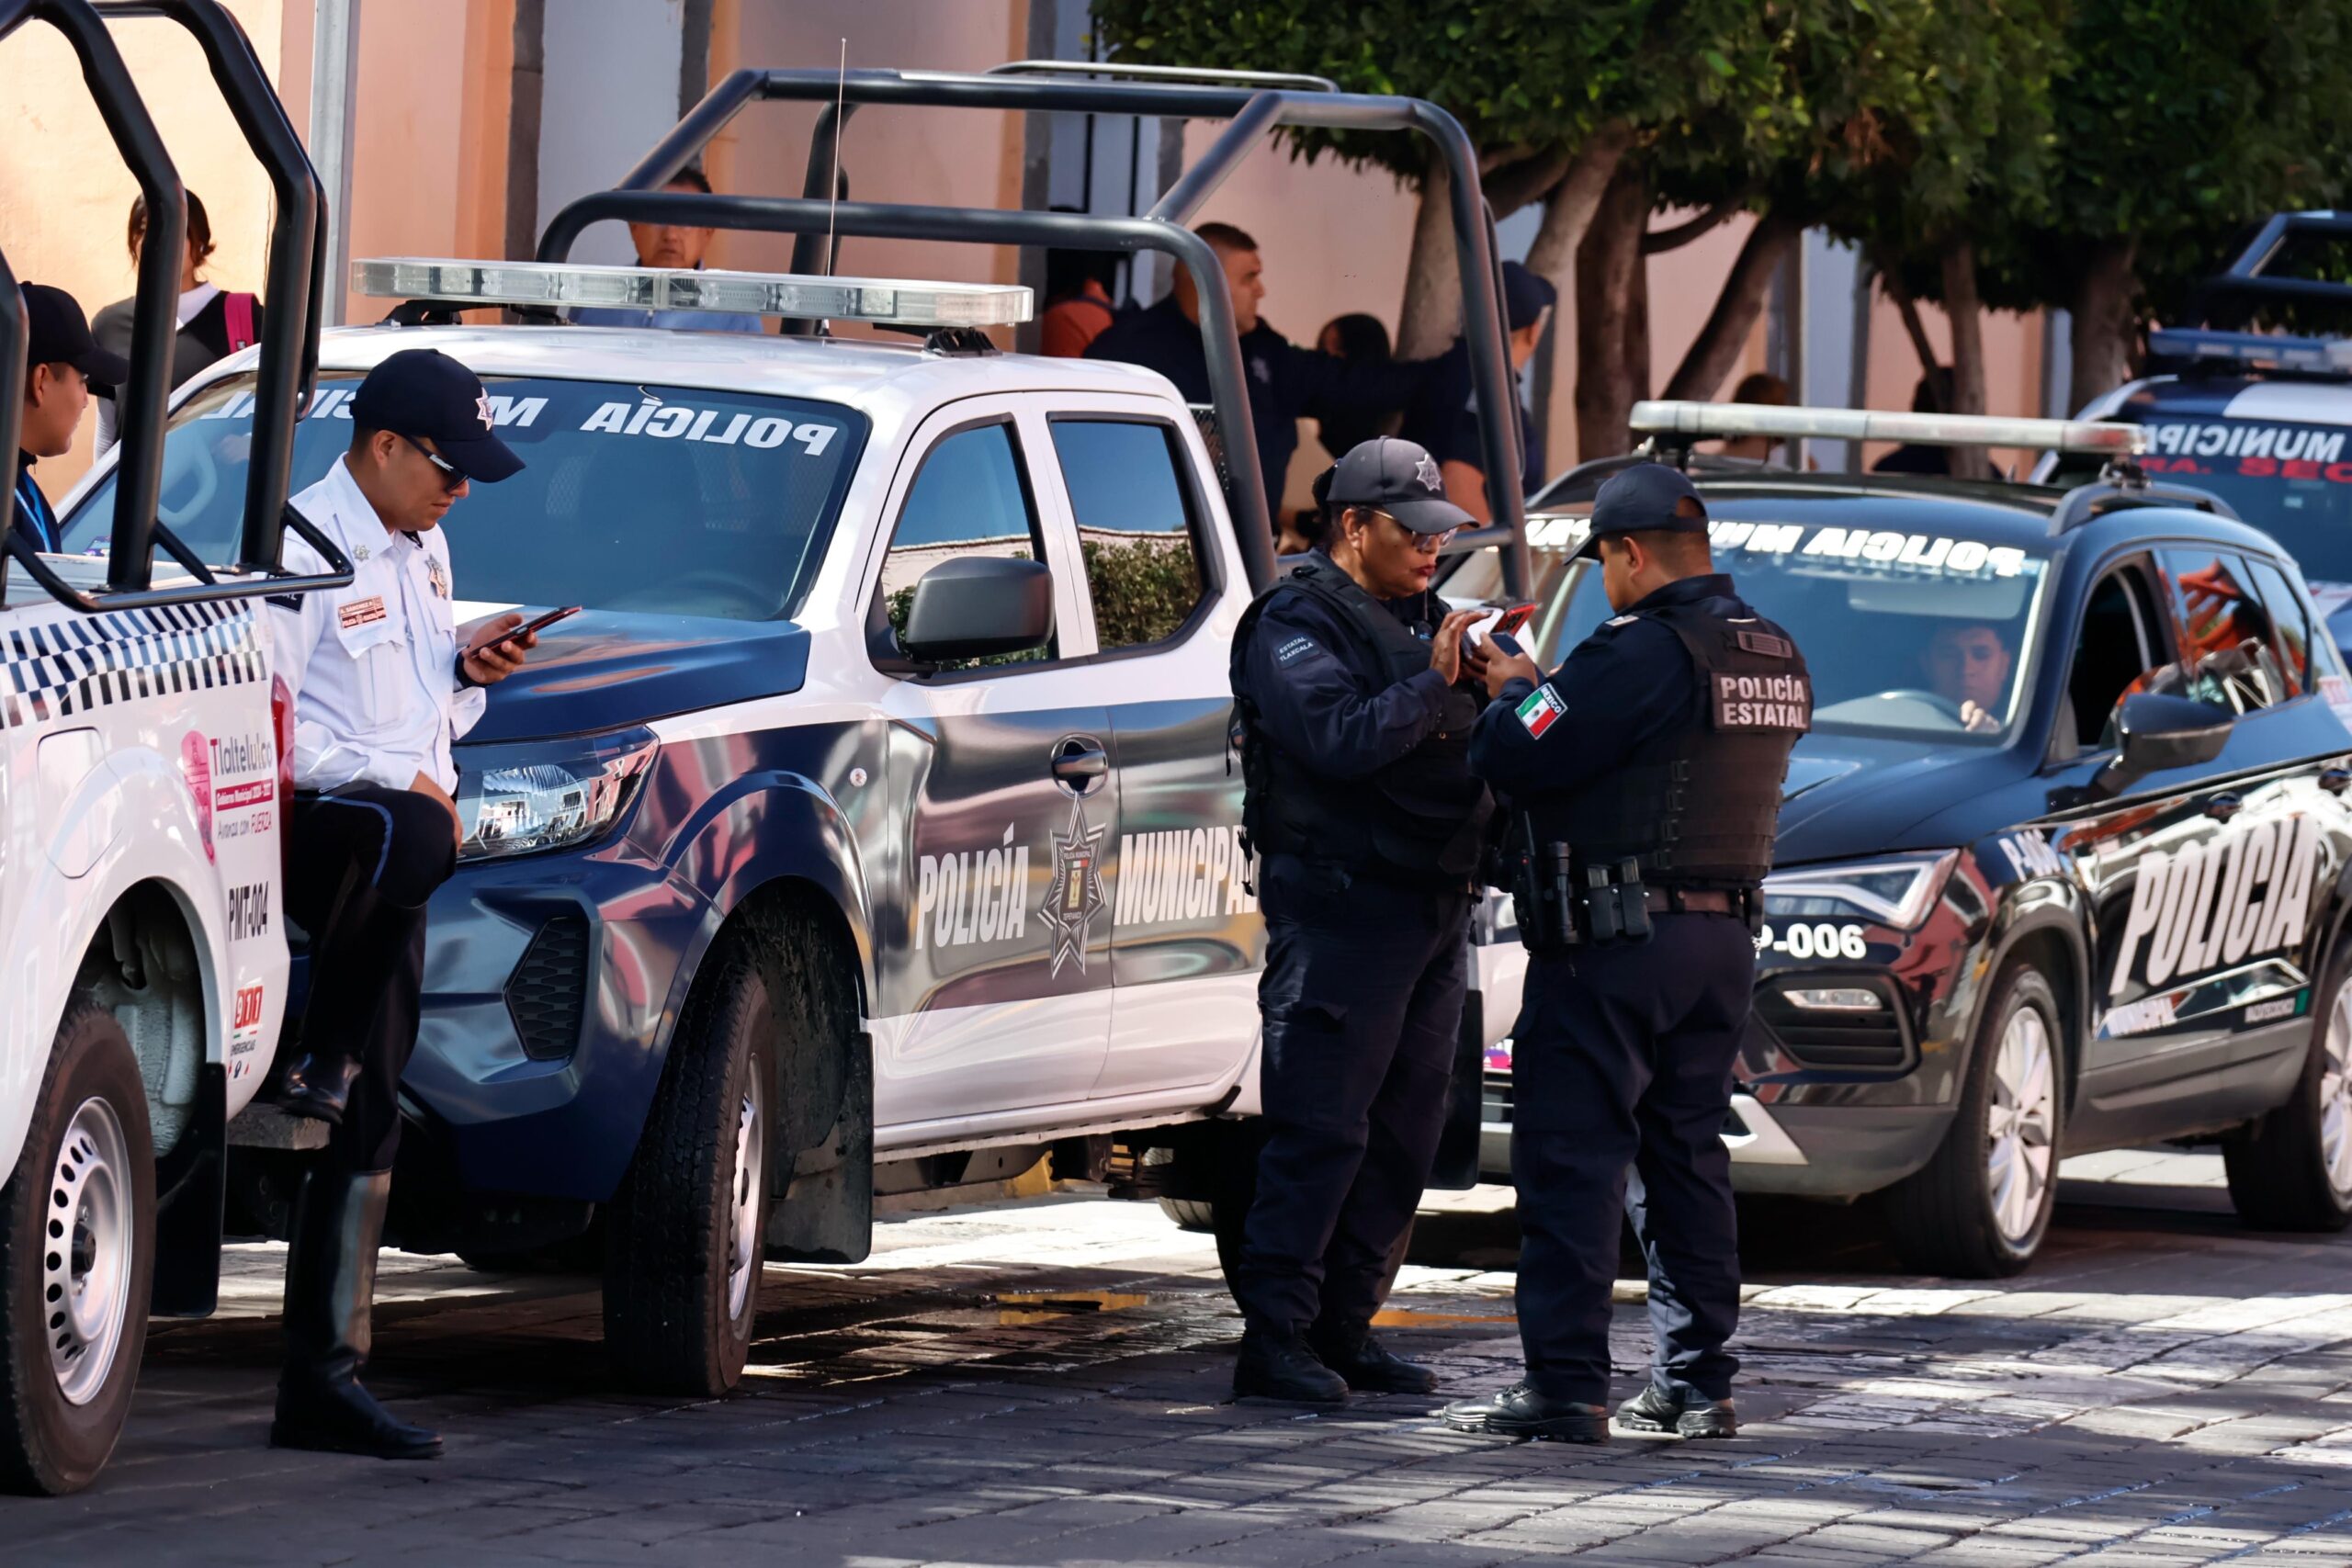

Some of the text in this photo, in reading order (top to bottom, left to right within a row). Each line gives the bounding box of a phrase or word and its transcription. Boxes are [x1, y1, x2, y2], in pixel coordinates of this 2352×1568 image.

[1279, 637, 1306, 653] ESTATAL
[1279, 642, 1313, 661] TLAXCALA
[1721, 675, 1805, 702] POLICÍA
[1723, 703, 1808, 729] ESTATAL
[210, 733, 273, 776] Tlaltelulco
[916, 822, 1029, 950] POLICÍA
[2109, 810, 2319, 996] POLICIA
[229, 881, 268, 942] PMT-004
[235, 987, 262, 1028] 911
